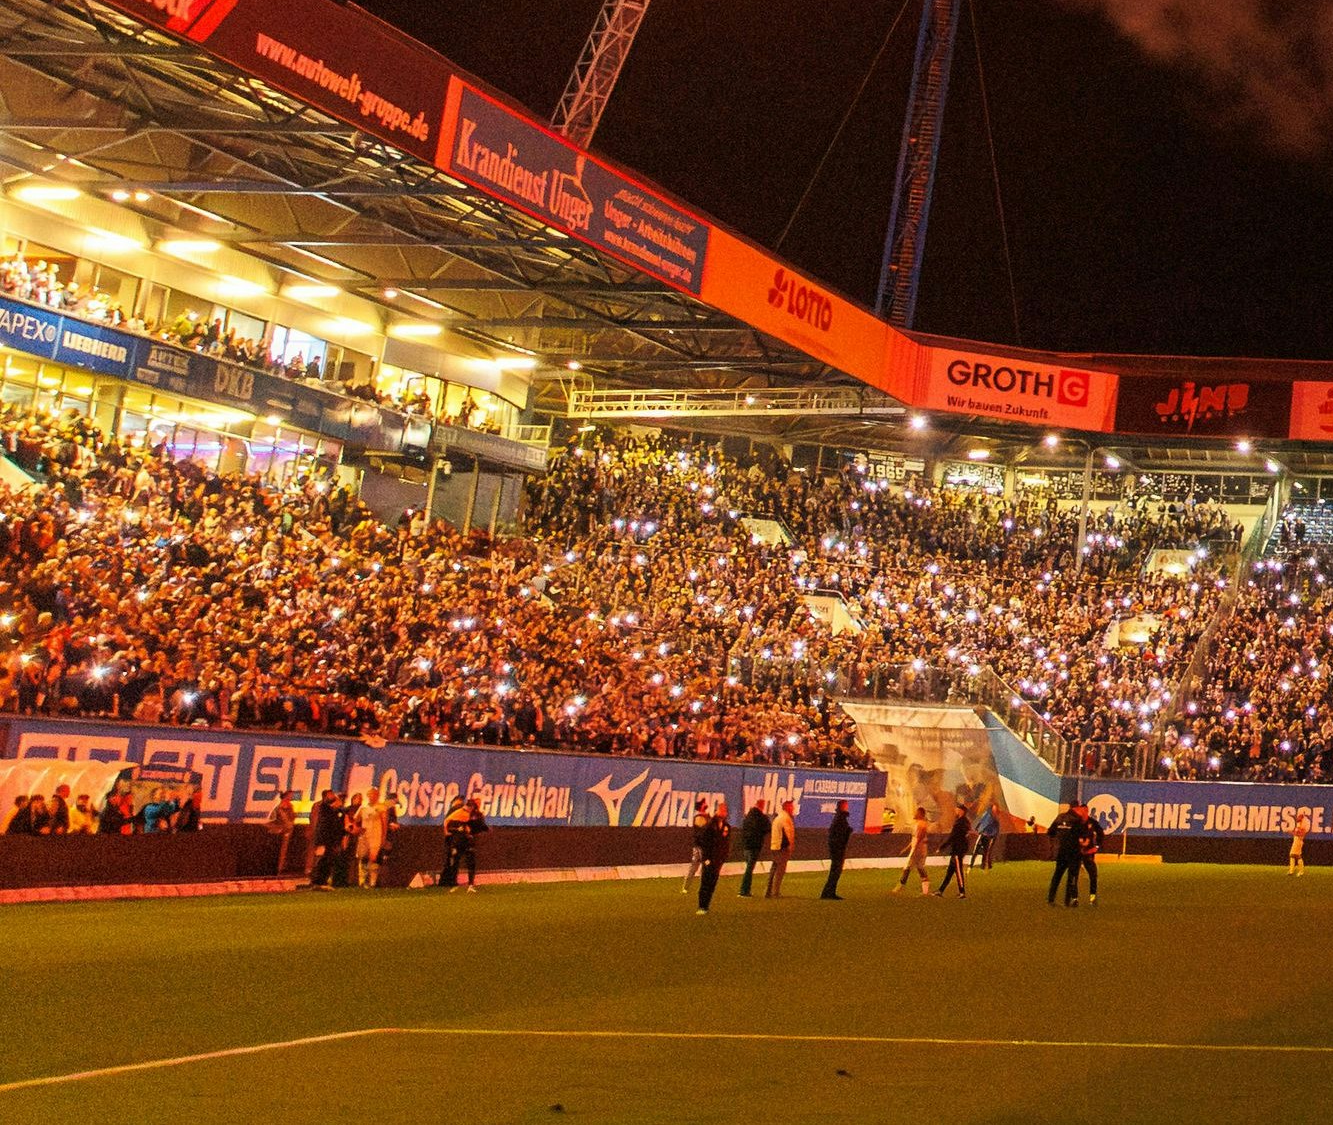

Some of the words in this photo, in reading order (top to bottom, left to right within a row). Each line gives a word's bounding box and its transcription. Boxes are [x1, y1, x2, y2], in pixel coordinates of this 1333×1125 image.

[257, 33, 429, 141] www.autowelt-gruppe.de
[455, 118, 549, 208] Krandienst
[548, 168, 593, 231] Unger
[787, 279, 833, 332] LOTTO
[62, 330, 128, 363] LIEBHERR
[947, 359, 1054, 398] GROTH
[947, 395, 966, 409] Wir
[968, 396, 1003, 413] bauen
